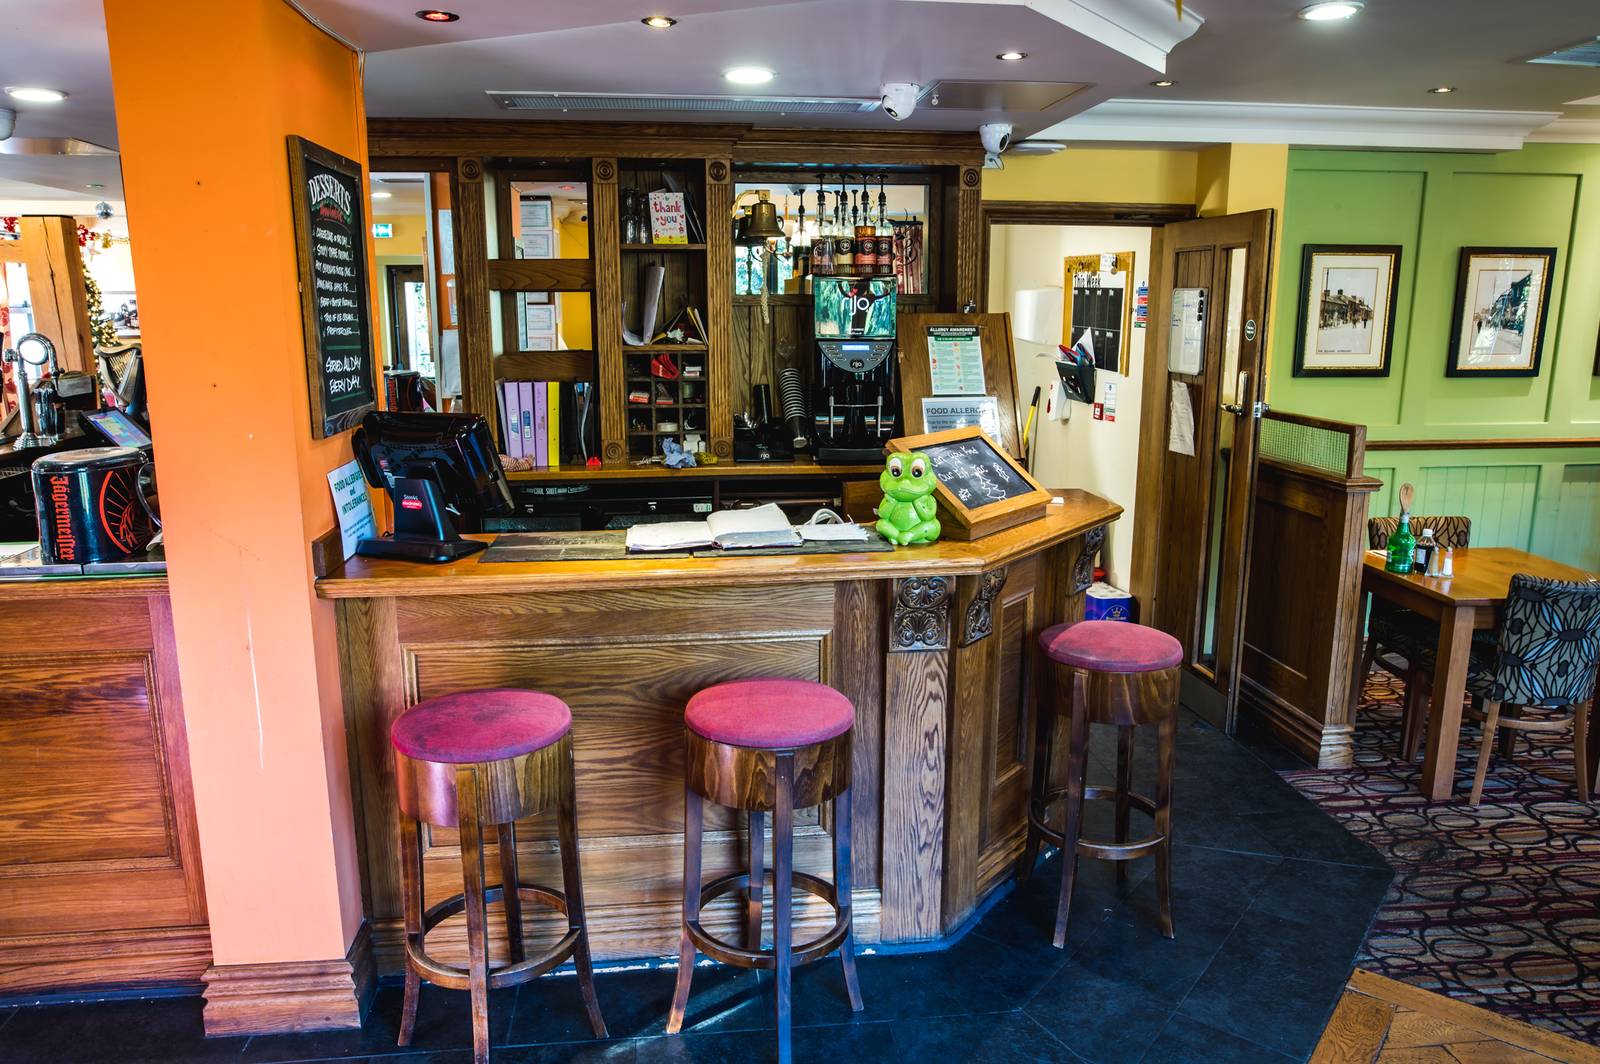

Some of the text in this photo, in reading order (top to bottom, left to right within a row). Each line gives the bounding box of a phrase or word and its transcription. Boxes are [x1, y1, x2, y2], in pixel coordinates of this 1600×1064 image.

[309, 174, 351, 216] DESSERTS
[652, 201, 682, 213] thank
[660, 215, 678, 227] you
[926, 407, 948, 415] FOOD
[333, 470, 364, 493] FOOD ALLERGIE
